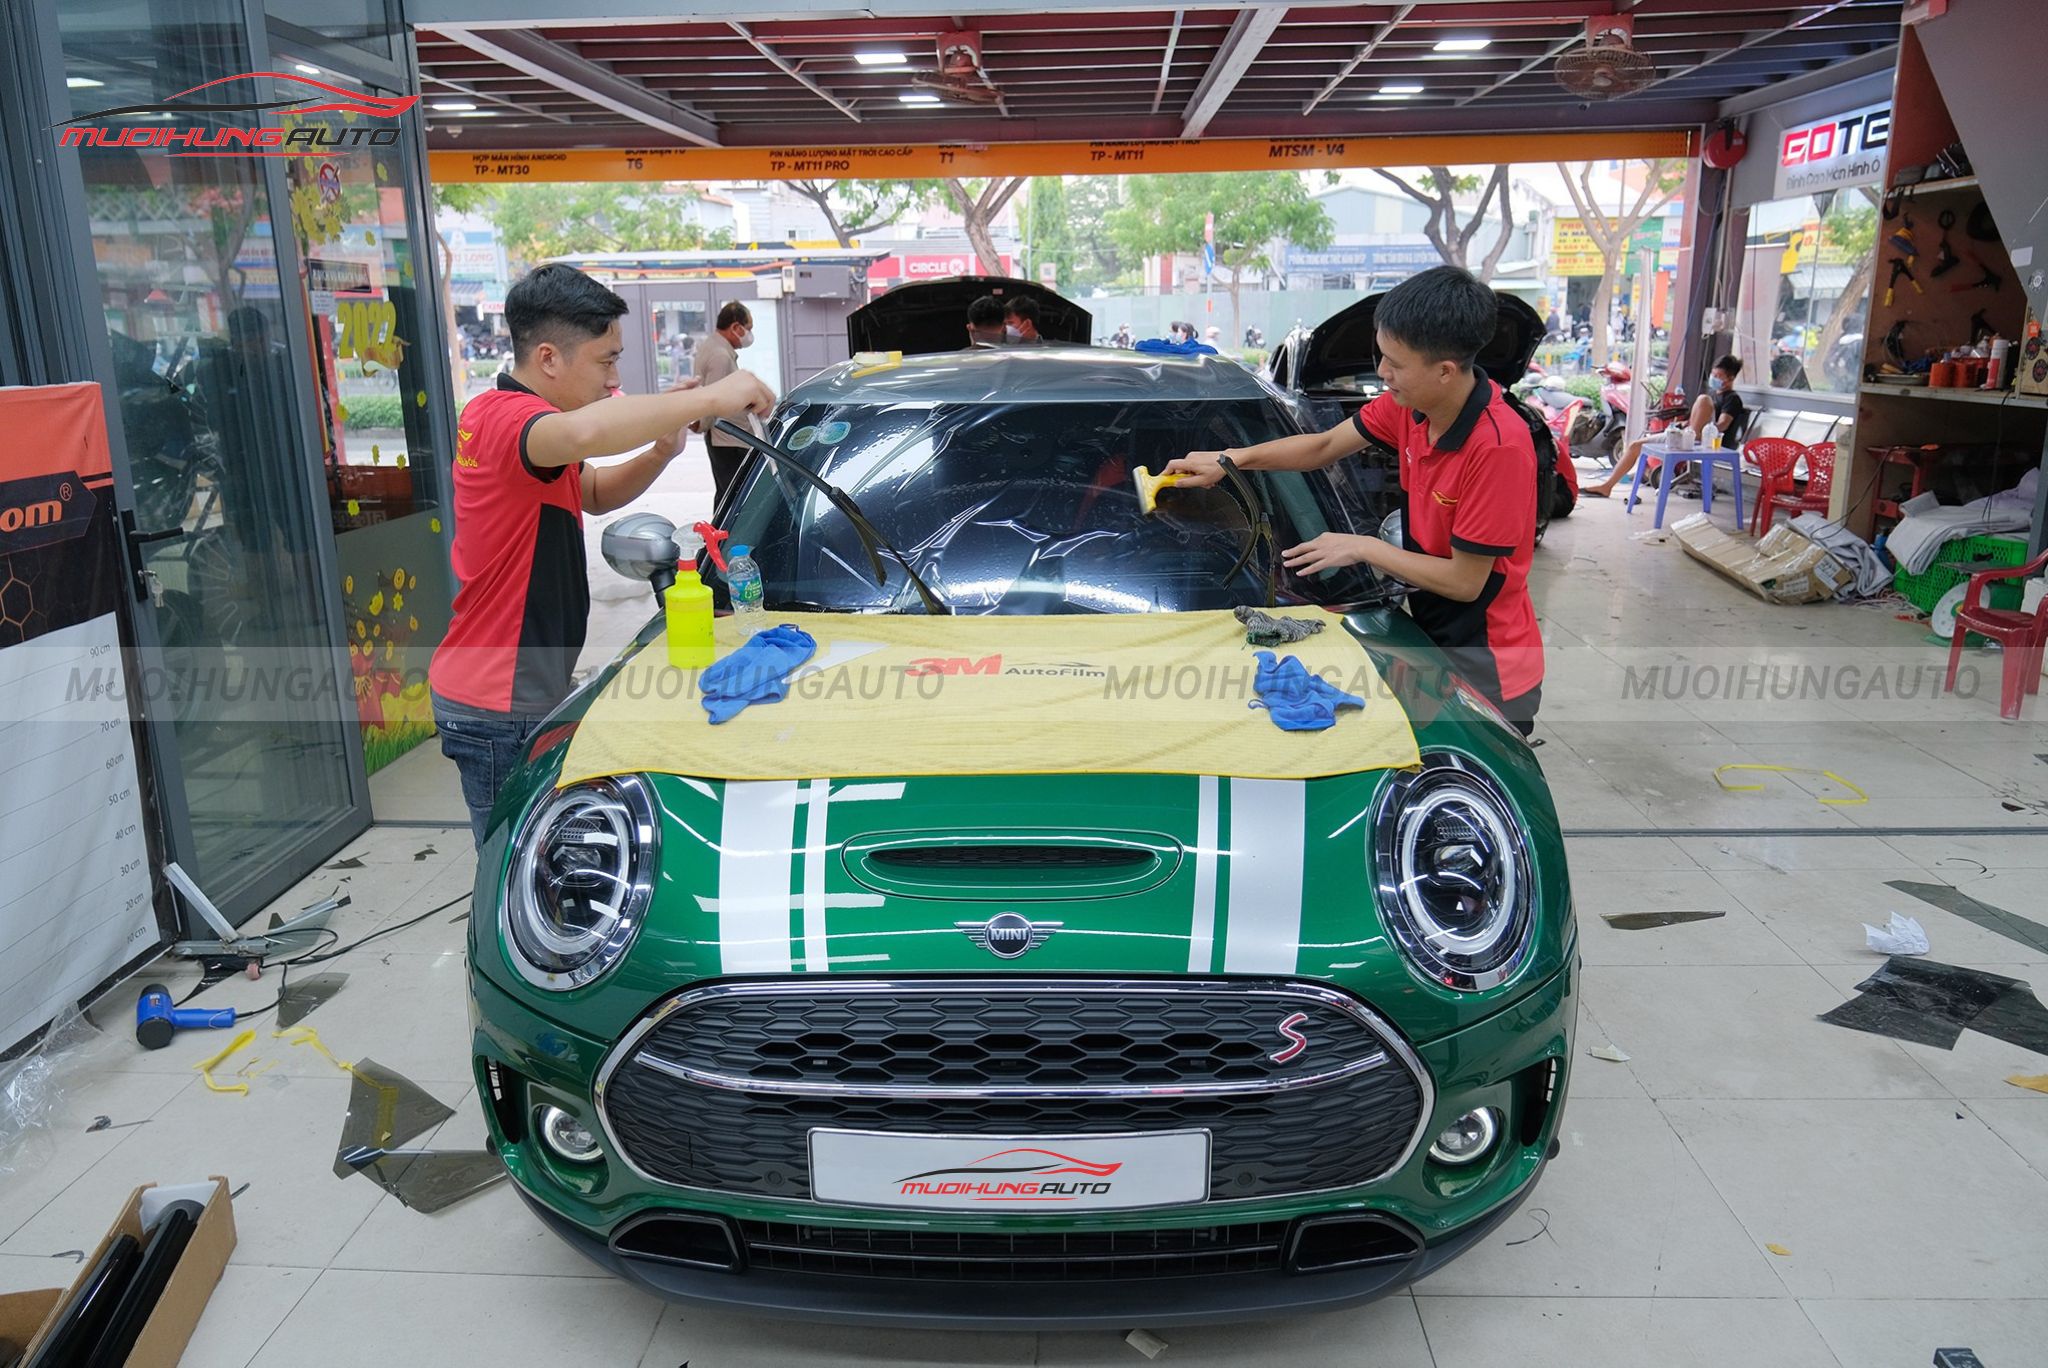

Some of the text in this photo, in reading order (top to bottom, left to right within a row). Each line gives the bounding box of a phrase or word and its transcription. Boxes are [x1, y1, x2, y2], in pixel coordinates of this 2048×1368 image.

[1090, 150, 1106, 161] TP
[1114, 150, 1145, 161] MT11
[1268, 144, 1316, 158] MTSM
[1325, 143, 1346, 156] V4
[474, 164, 489, 175] TP
[496, 164, 530, 175] MT30
[626, 158, 643, 170] T6
[770, 161, 785, 171] TP
[794, 161, 822, 171] MT11
[824, 160, 850, 170] PRO
[909, 262, 948, 273] CIRCLE
[337, 300, 396, 359] 2022
[89, 643, 111, 659] 90 cm
[905, 653, 1106, 678] 3M AutoFilm
[100, 717, 121, 733] 70 cm
[105, 752, 125, 770] 60 cm
[108, 788, 131, 806] 50 cm
[114, 823, 136, 841] 40 cm
[119, 858, 141, 877] 30 cm
[125, 892, 145, 912] 20 cm
[127, 926, 147, 945] 10 cm
[989, 928, 1029, 941] MINI
[1269, 1012, 1309, 1064] S
